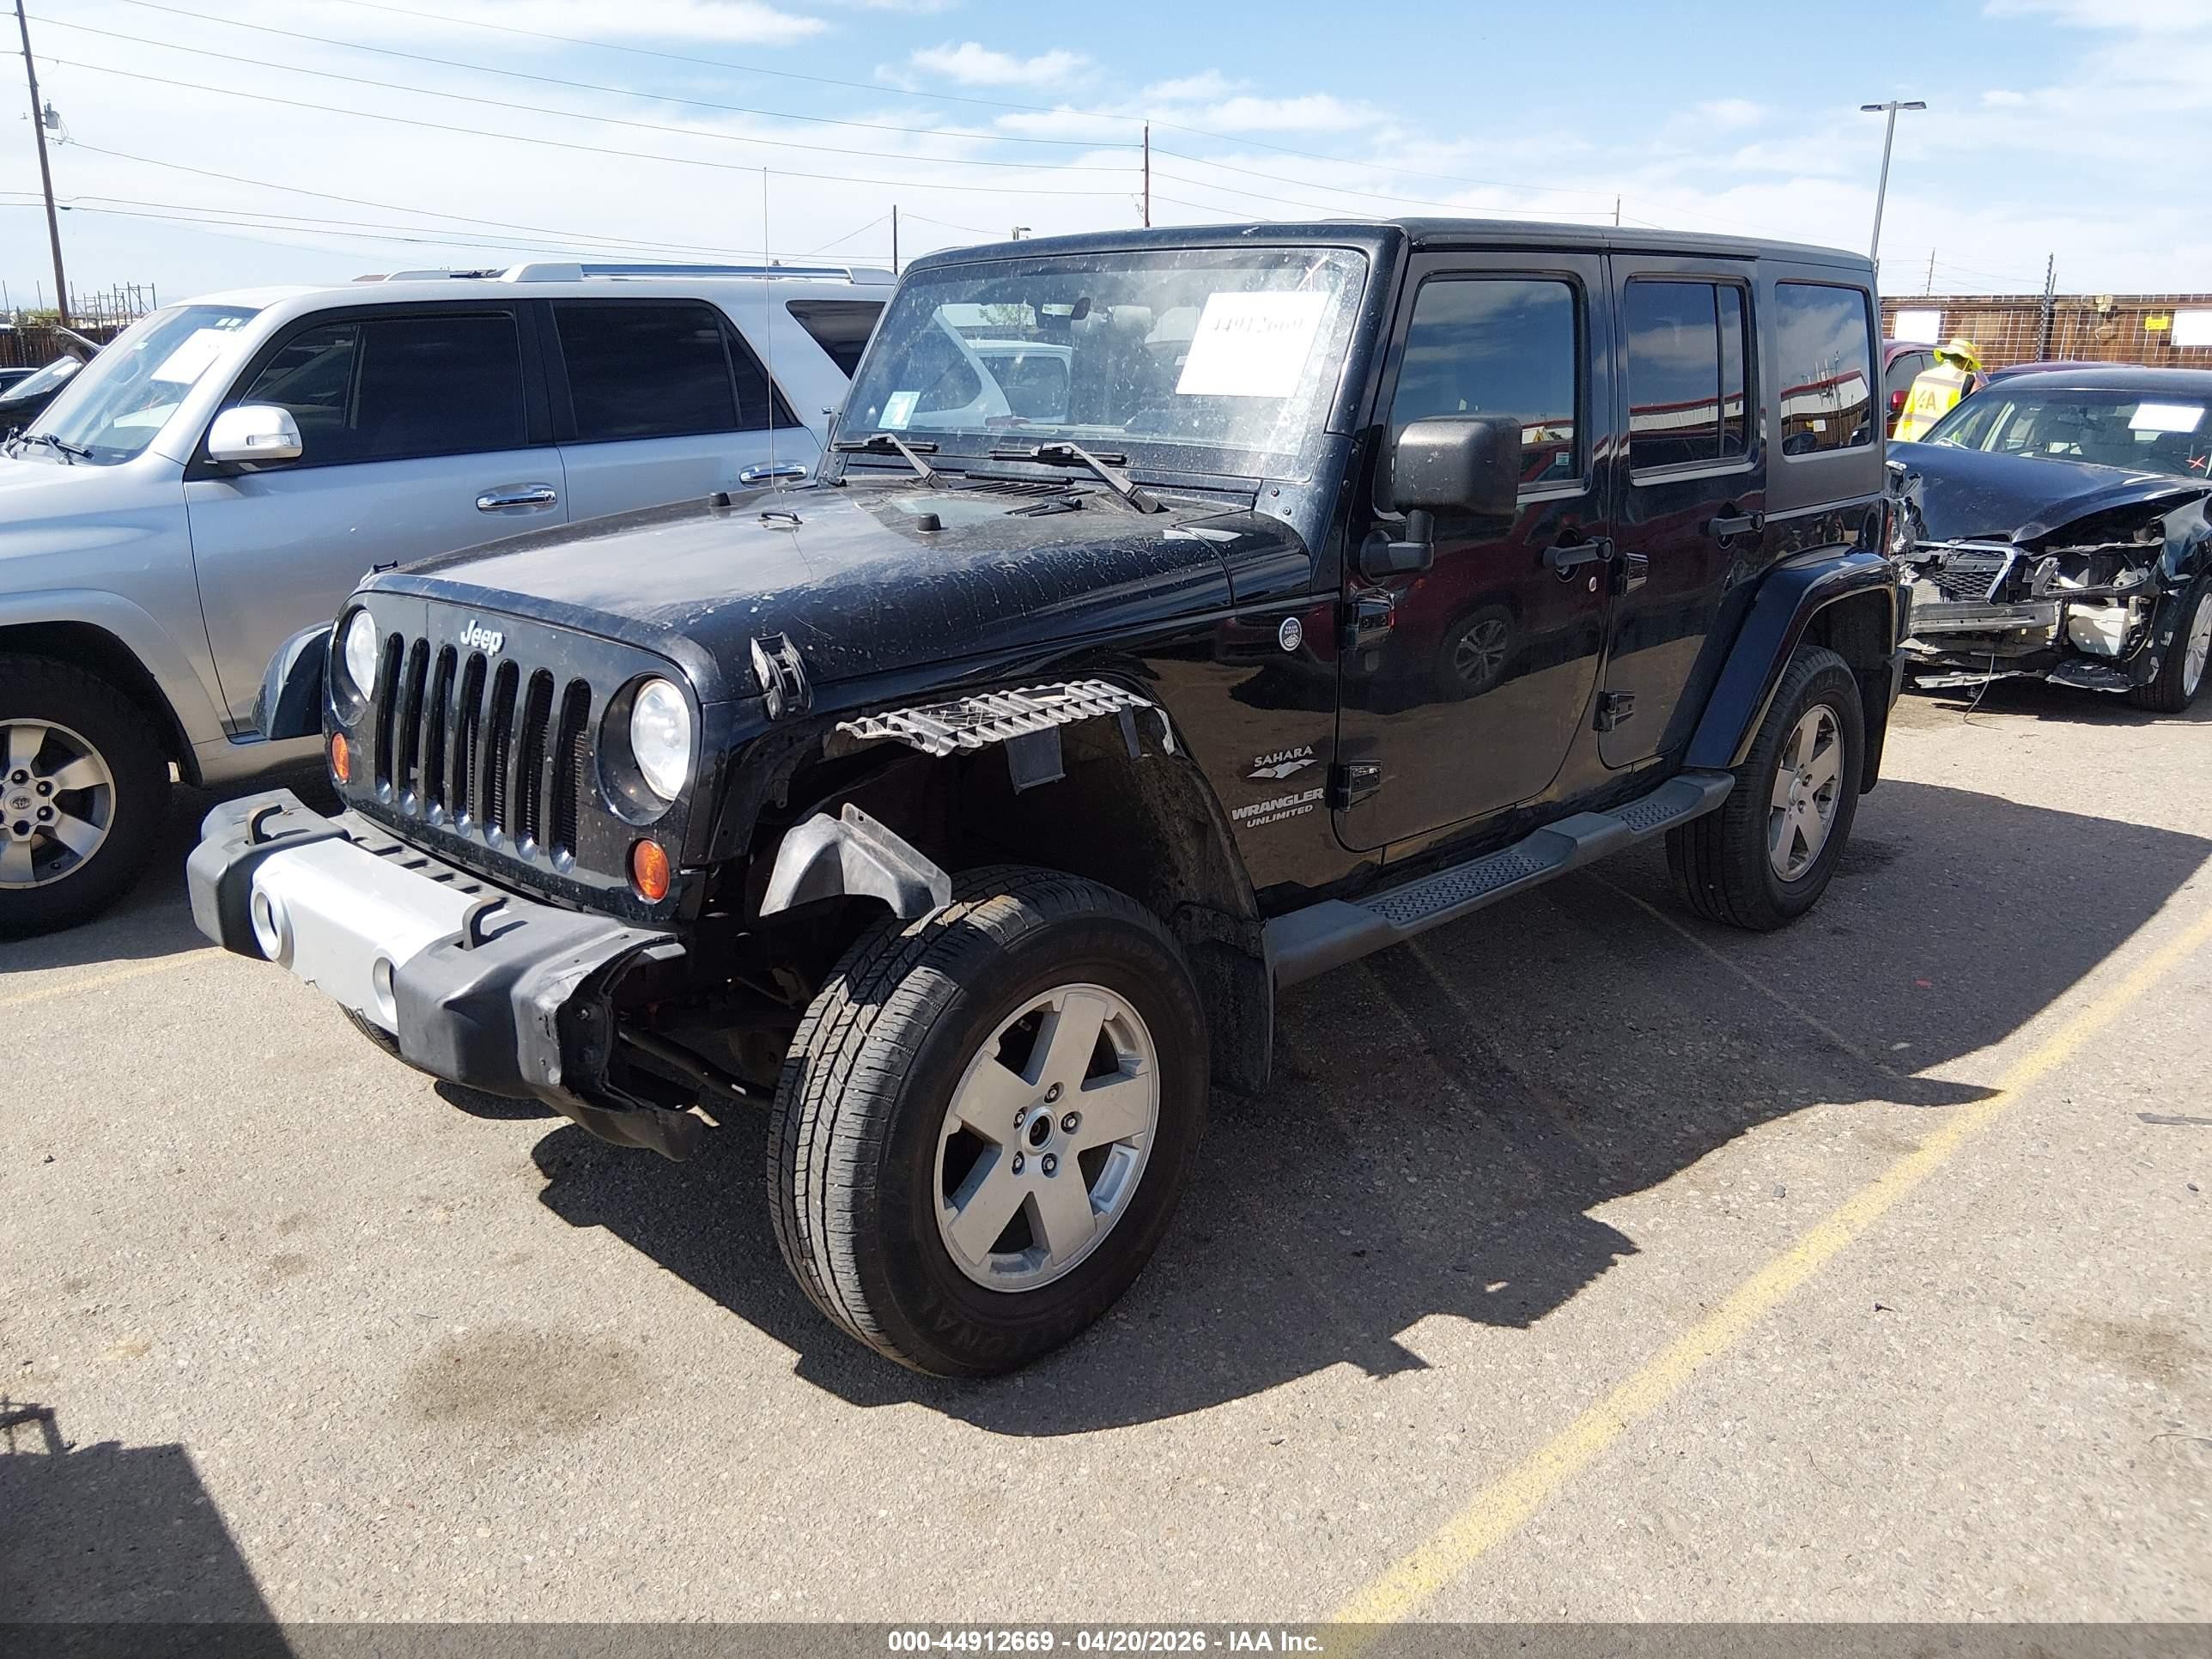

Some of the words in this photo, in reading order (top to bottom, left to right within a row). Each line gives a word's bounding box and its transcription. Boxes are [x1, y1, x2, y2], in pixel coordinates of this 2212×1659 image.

[460, 619, 504, 657] Jeep
[1255, 745, 1313, 767] SAHARA
[1232, 788, 1324, 820] WRANGLER
[1247, 805, 1313, 828] UNLIMITED
